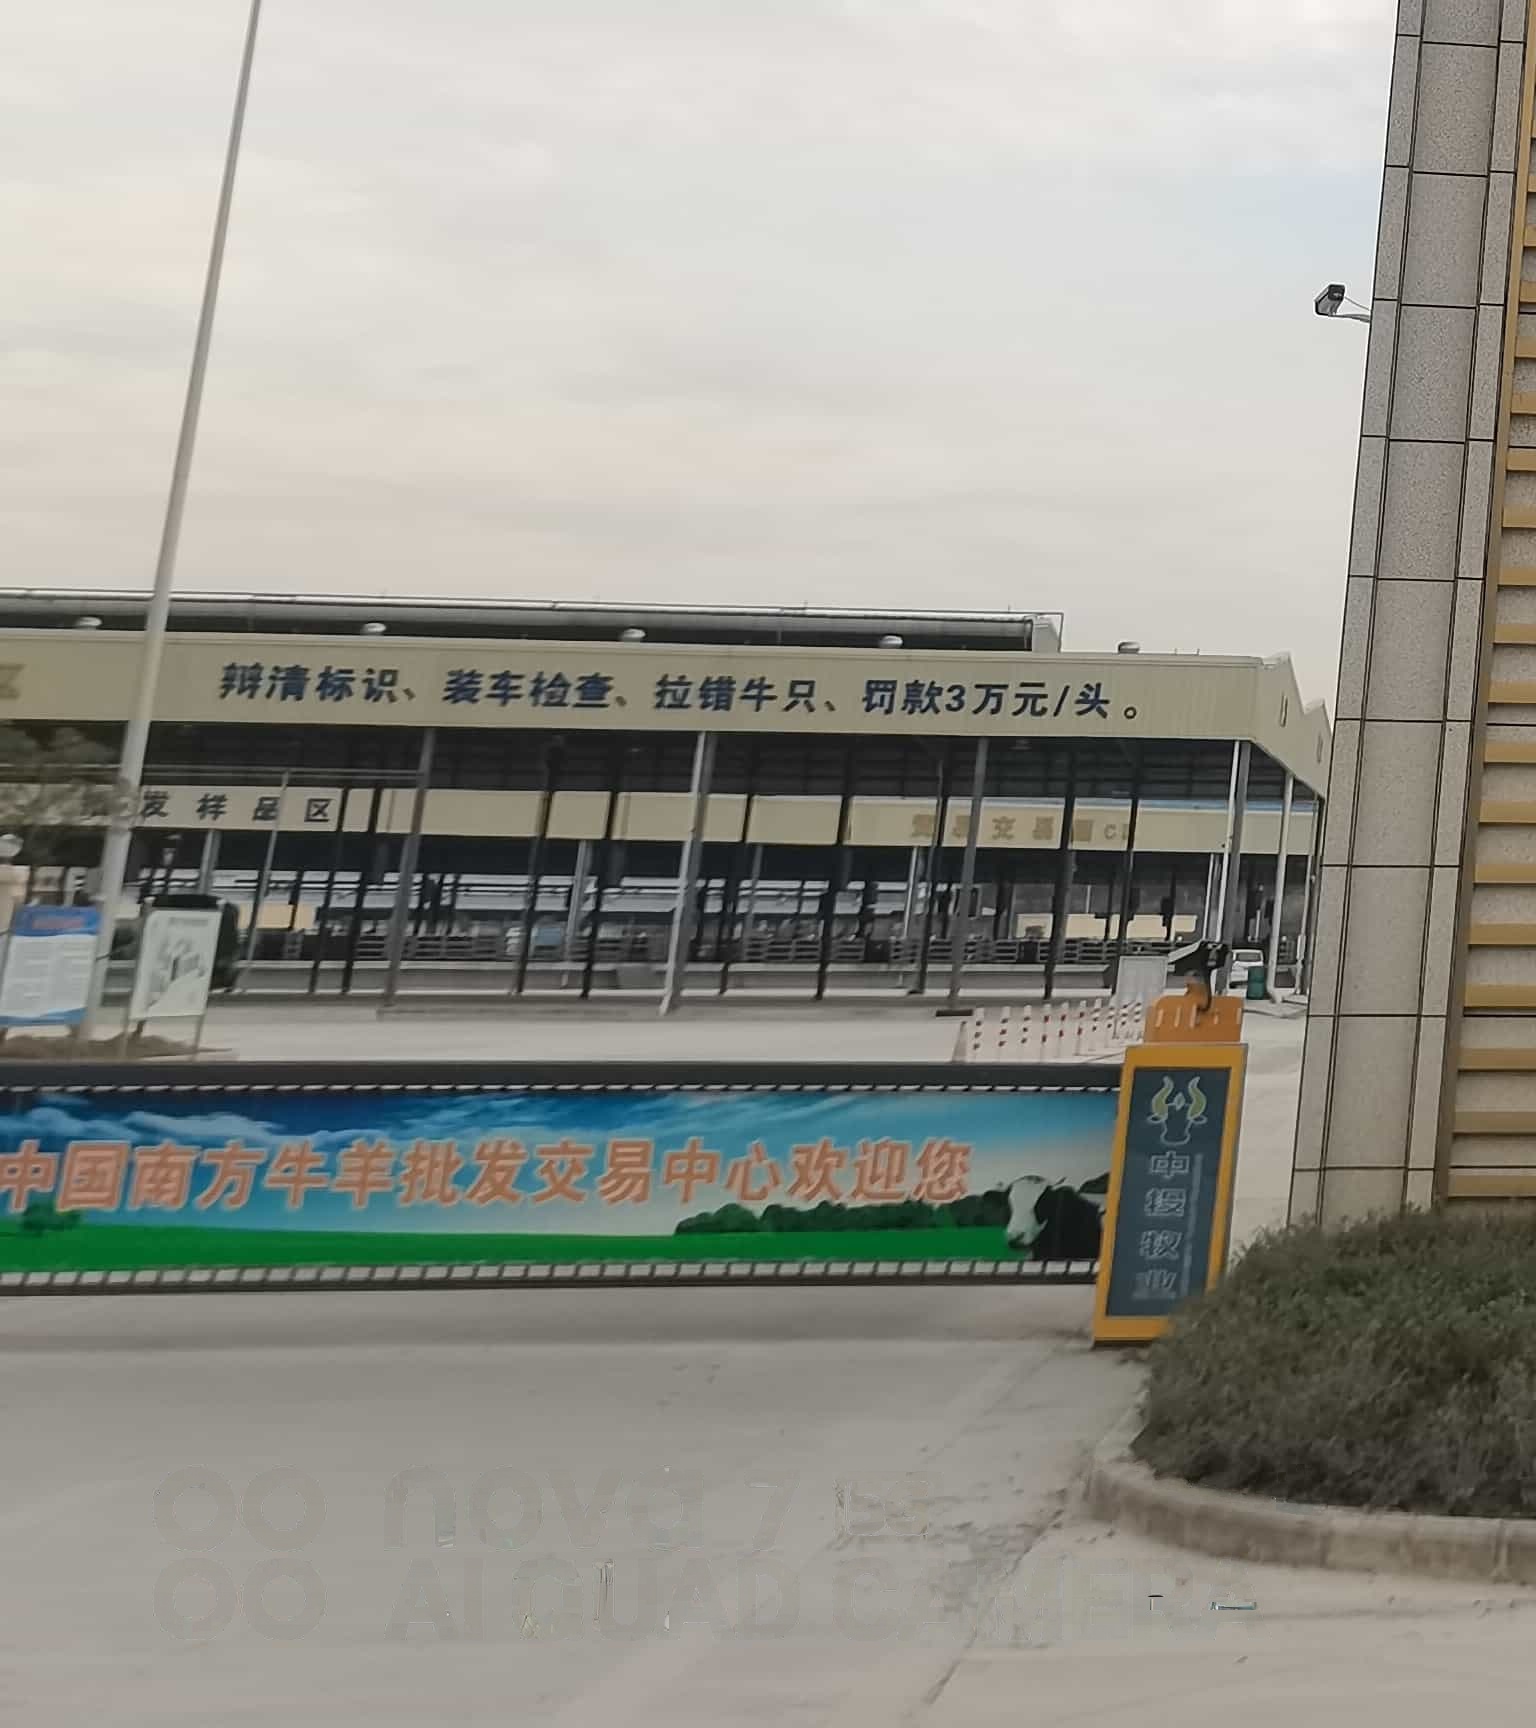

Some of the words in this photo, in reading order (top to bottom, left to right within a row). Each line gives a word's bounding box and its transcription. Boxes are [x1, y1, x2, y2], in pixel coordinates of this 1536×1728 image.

[0, 1136, 973, 1212] 中国南方牛羊批发交易中心欢迎您
